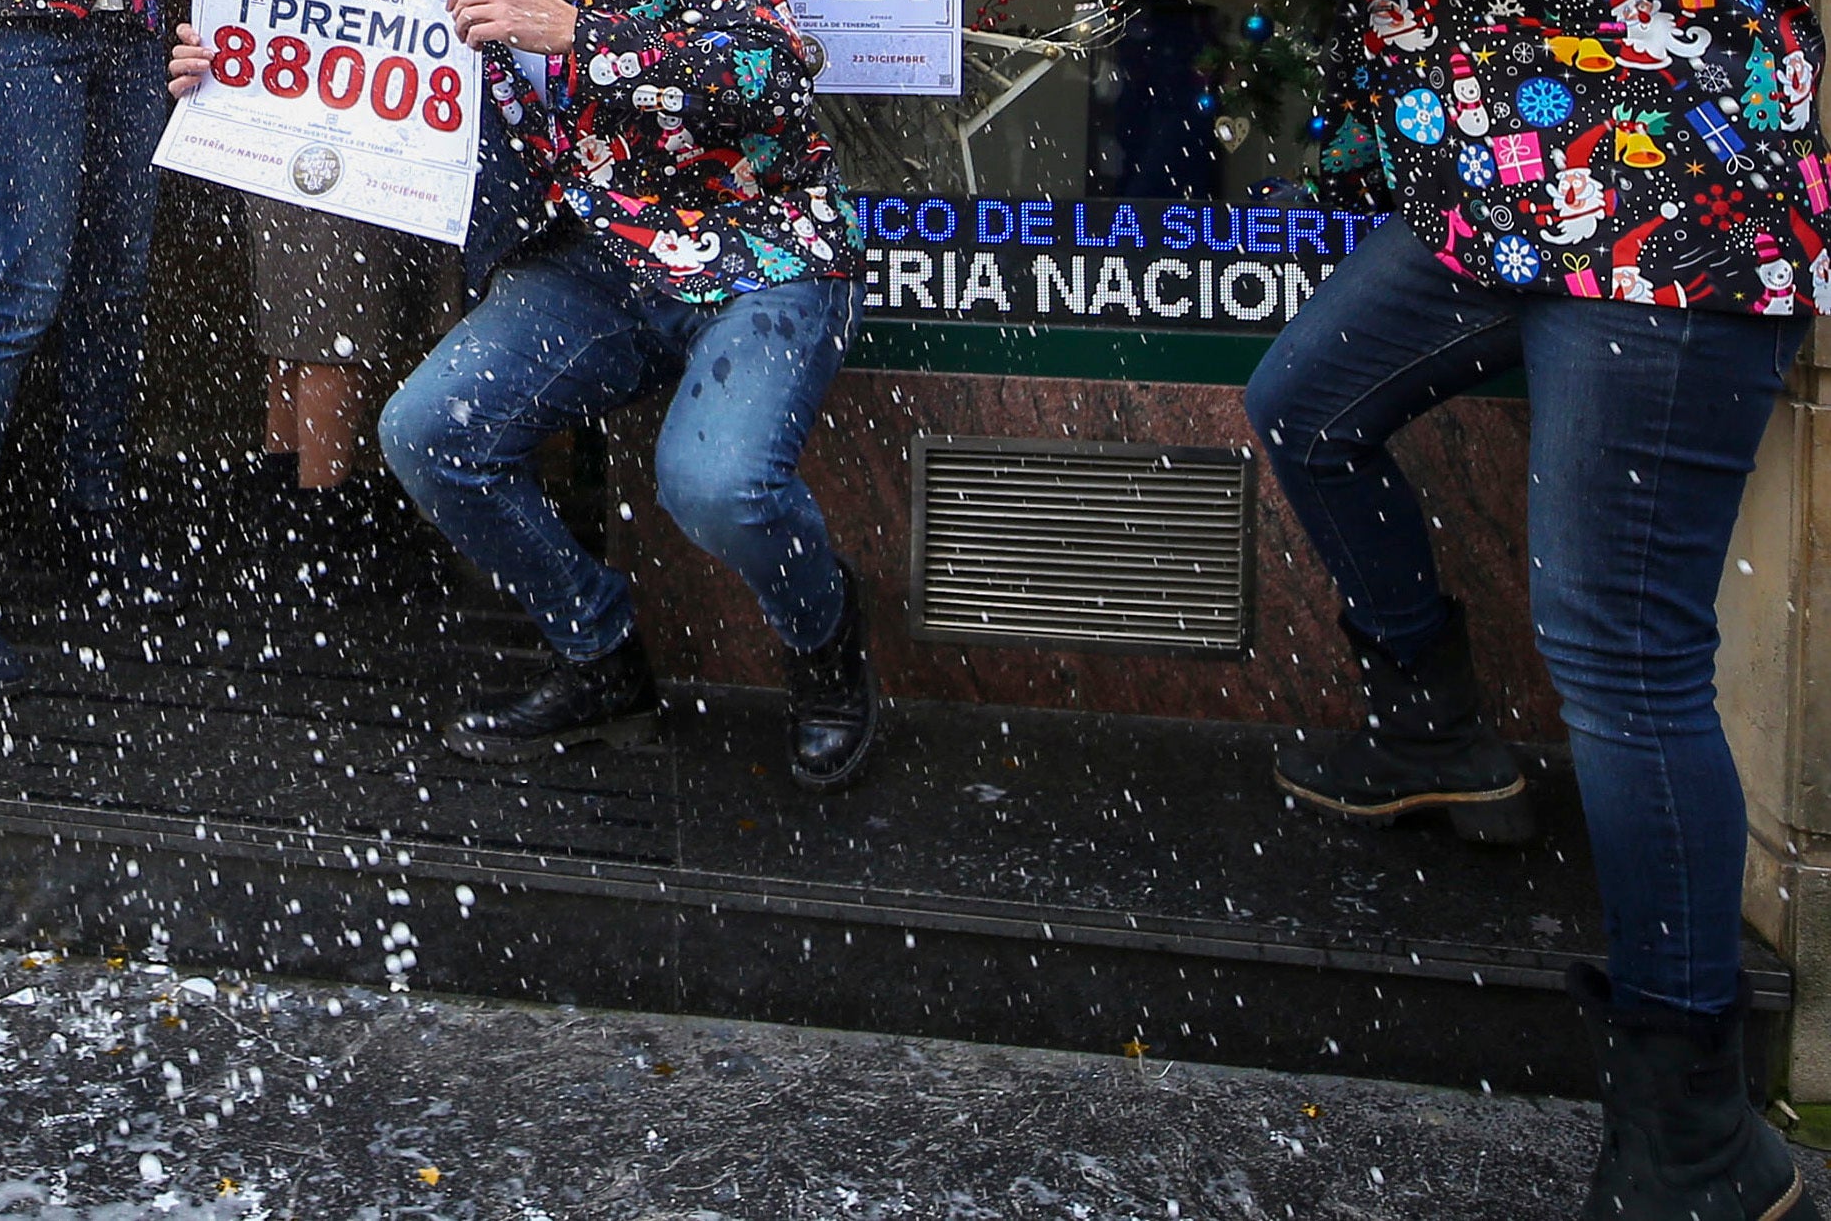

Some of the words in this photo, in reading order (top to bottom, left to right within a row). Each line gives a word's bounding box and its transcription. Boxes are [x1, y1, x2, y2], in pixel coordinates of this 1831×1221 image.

[852, 55, 865, 63] 22
[868, 55, 926, 63] DICIEMBRE
[210, 25, 462, 132] 88008
[237, 147, 283, 166] NAVIDAD
[859, 197, 957, 242] CO
[976, 199, 1054, 246] DE
[1075, 203, 1145, 248] LA
[1162, 205, 1391, 255] SUERT
